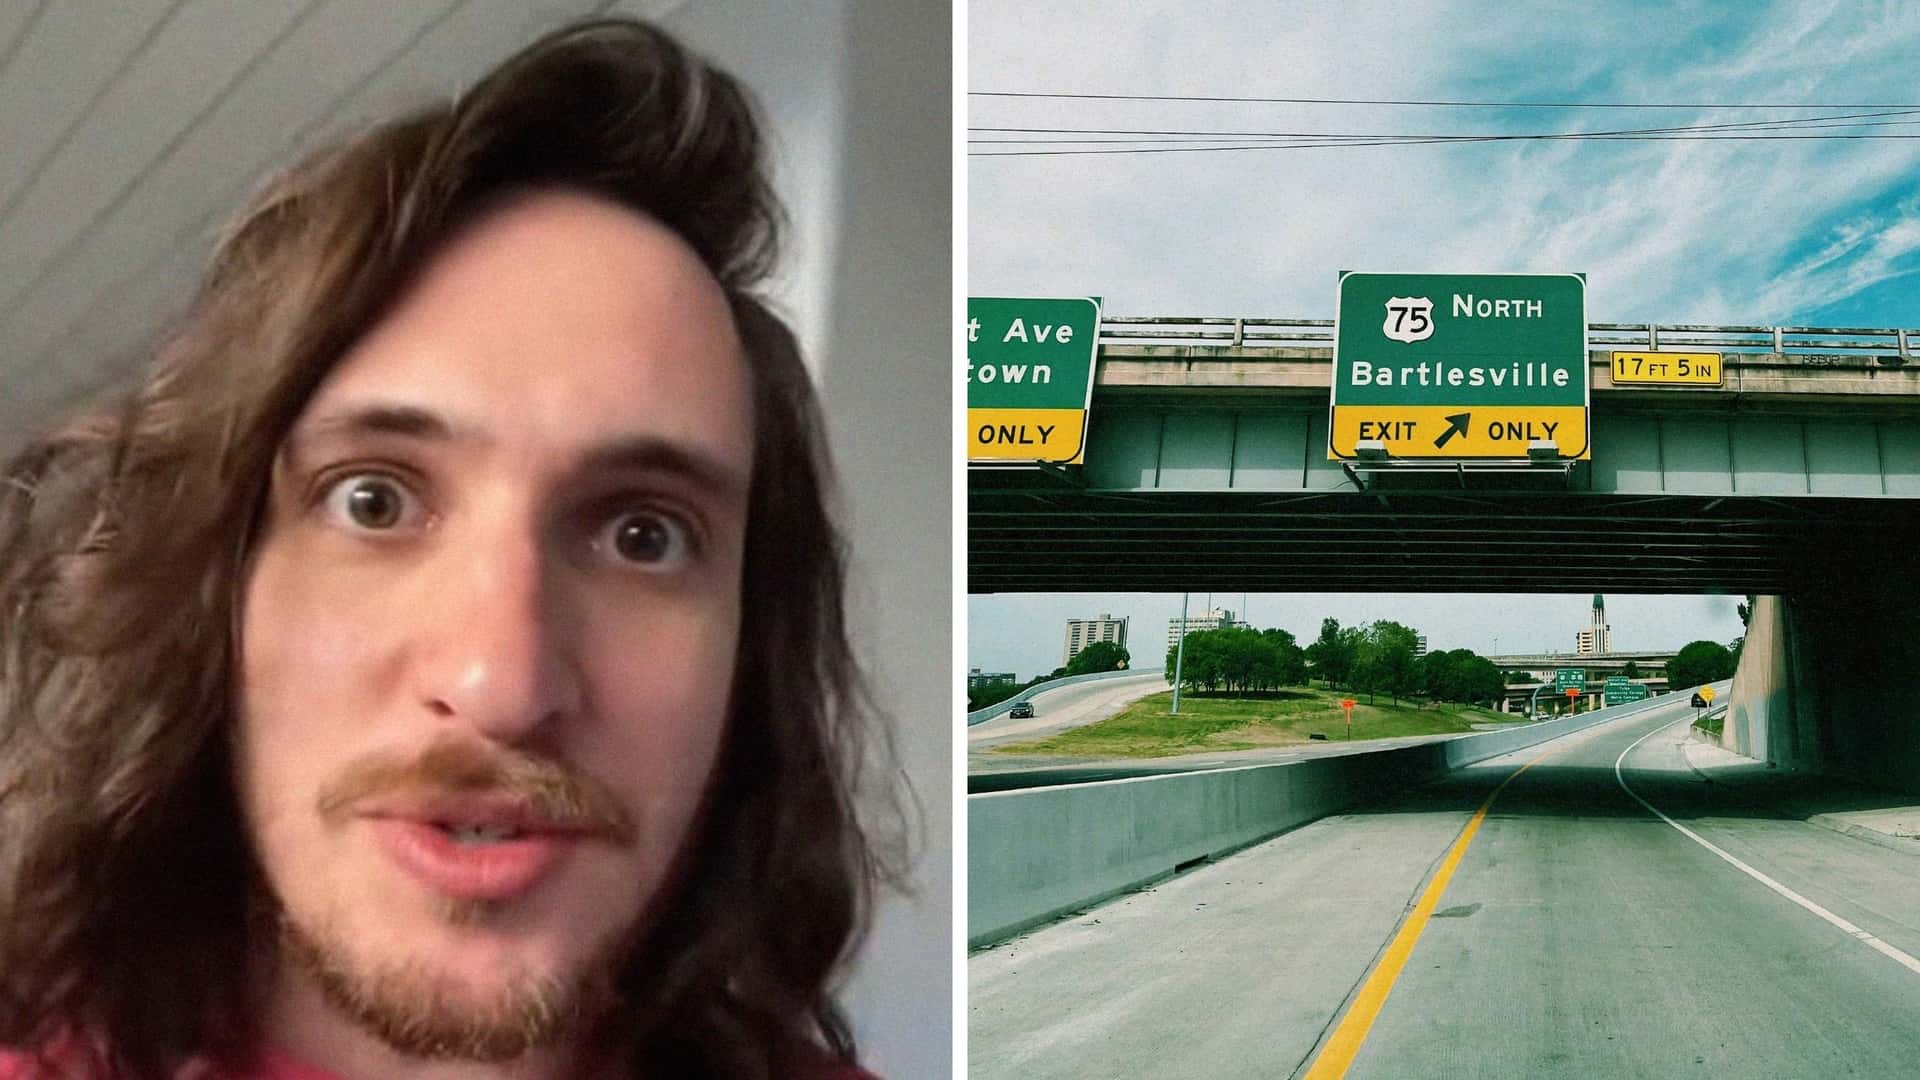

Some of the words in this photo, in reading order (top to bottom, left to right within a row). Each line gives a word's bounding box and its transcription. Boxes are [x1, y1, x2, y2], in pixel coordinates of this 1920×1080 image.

[1002, 318, 1073, 343] Ave
[1389, 306, 1429, 334] 75
[1351, 361, 1569, 387] Bartlesville
[1618, 357, 1643, 376] 17
[1649, 364, 1668, 376] FT
[1678, 359, 1690, 376] 5
[1696, 365, 1711, 377] IN
[978, 425, 1055, 444] ONLY
[1359, 421, 1417, 441] EXIT
[1488, 421, 1559, 441] ONLY
